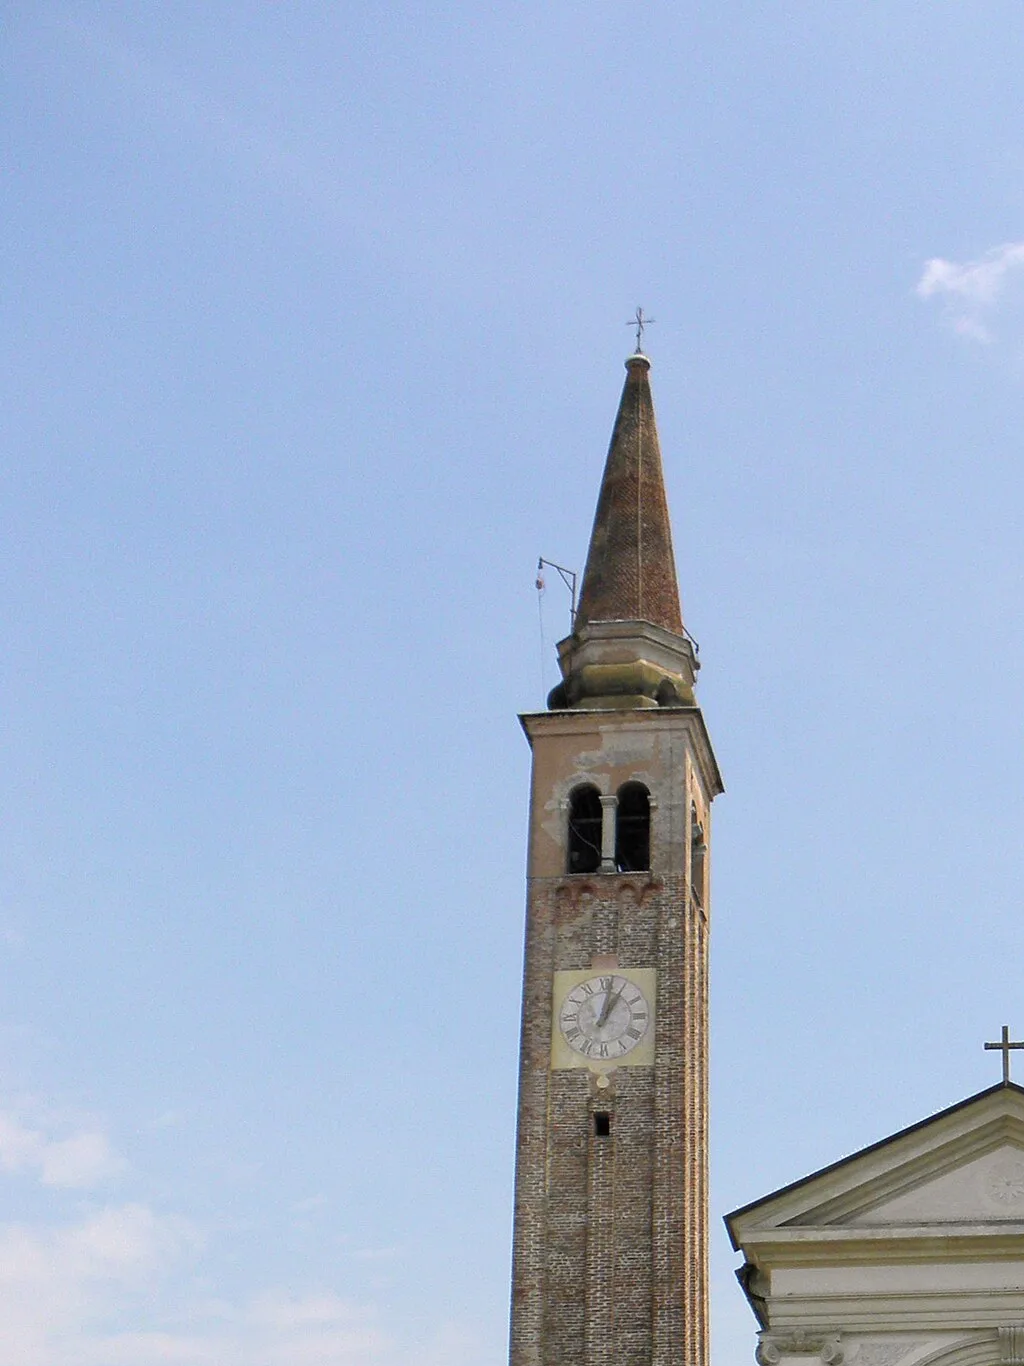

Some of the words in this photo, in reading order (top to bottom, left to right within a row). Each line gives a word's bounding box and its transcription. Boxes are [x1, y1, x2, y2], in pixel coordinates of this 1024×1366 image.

[580, 983, 594, 995] XI
[568, 996, 582, 1007] X
[628, 995, 642, 1006] II
[563, 1013, 577, 1022] IX
[632, 1012, 646, 1021] III
[565, 1026, 580, 1042] VIII
[580, 1037, 593, 1055] VII
[599, 1041, 609, 1057] VI
